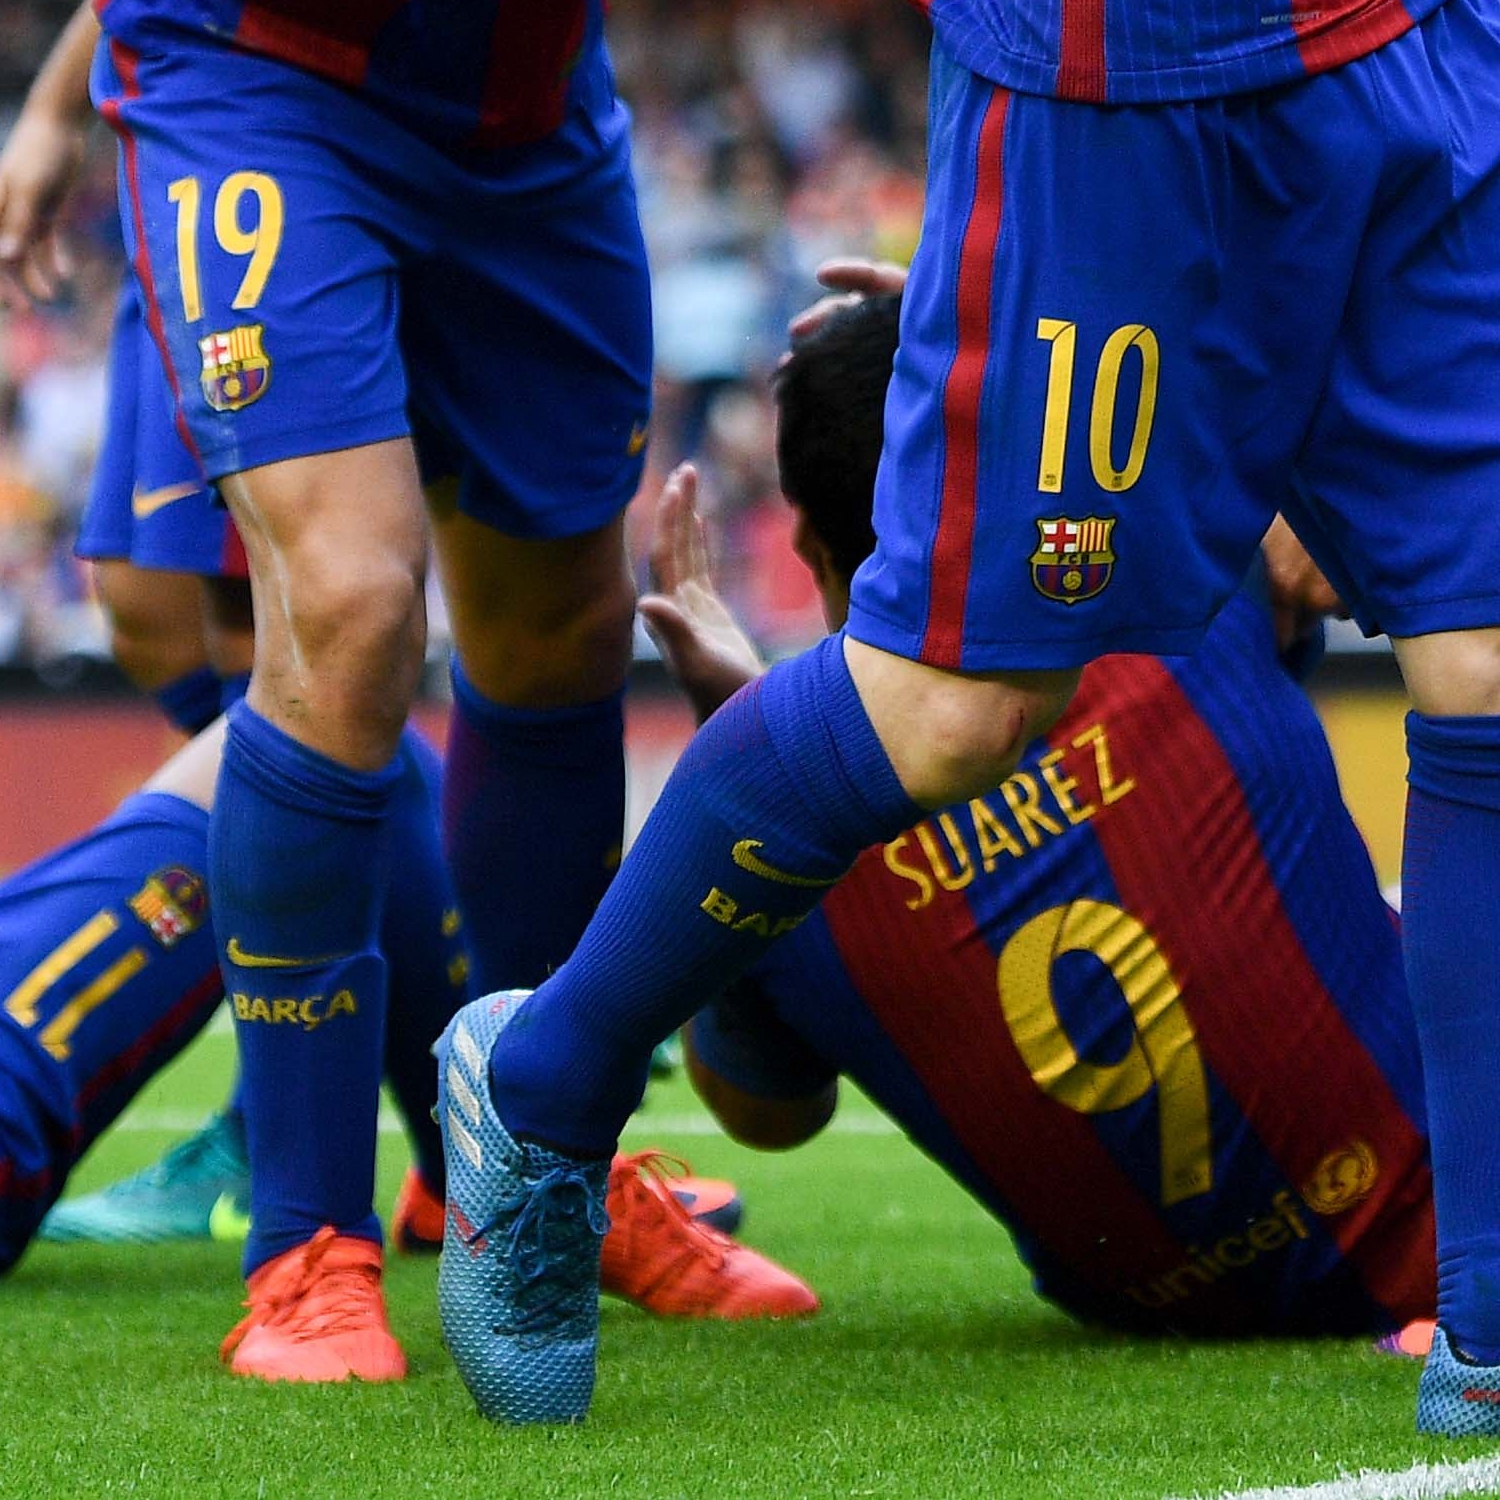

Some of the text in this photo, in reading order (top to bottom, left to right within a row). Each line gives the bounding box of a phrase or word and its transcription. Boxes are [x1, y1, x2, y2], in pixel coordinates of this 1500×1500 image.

[168, 170, 284, 324] 19
[1037, 317, 1160, 493] 10
[883, 723, 1137, 911] SUAREZ
[700, 886, 805, 937] BAR
[231, 988, 357, 1031] BARÇA
[997, 898, 1214, 1209] 9
[1123, 1189, 1310, 1309] unicef
